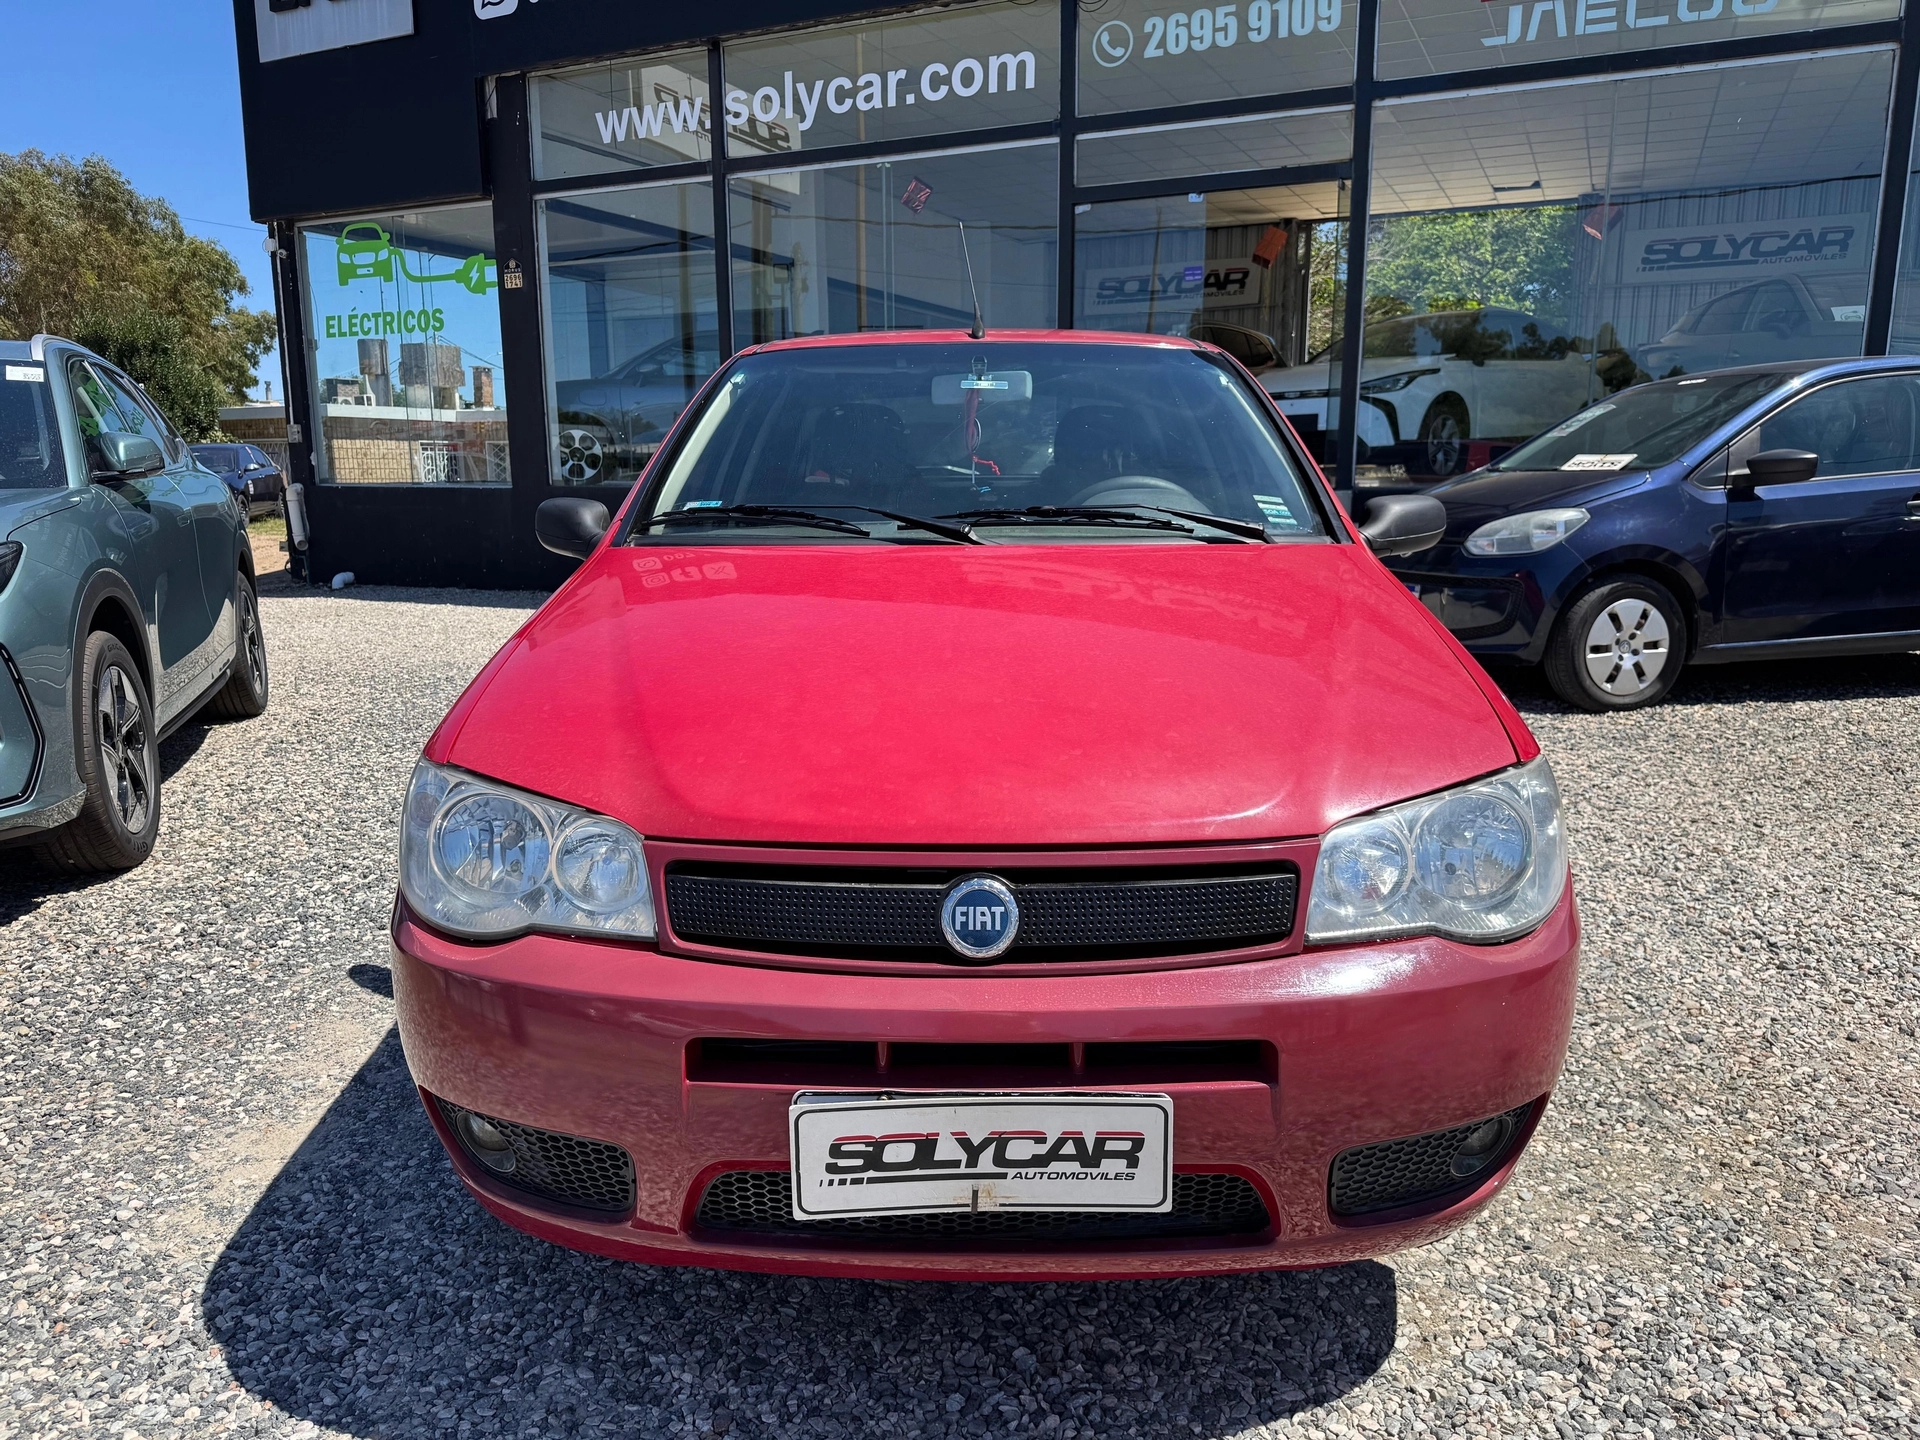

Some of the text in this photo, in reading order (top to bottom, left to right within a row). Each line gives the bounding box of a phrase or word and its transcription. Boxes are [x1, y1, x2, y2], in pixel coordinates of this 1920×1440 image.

[1143, 0, 1342, 59] 2695 9109
[1641, 225, 1855, 266] SOLYCAR
[1760, 252, 1847, 265] AUTOMOVILES
[325, 306, 445, 339] ELÉCTRICOS
[955, 906, 1005, 931] FIAT
[824, 1130, 1146, 1175] SOLYCAR
[1010, 1171, 1136, 1182] AUTOMOVILES
